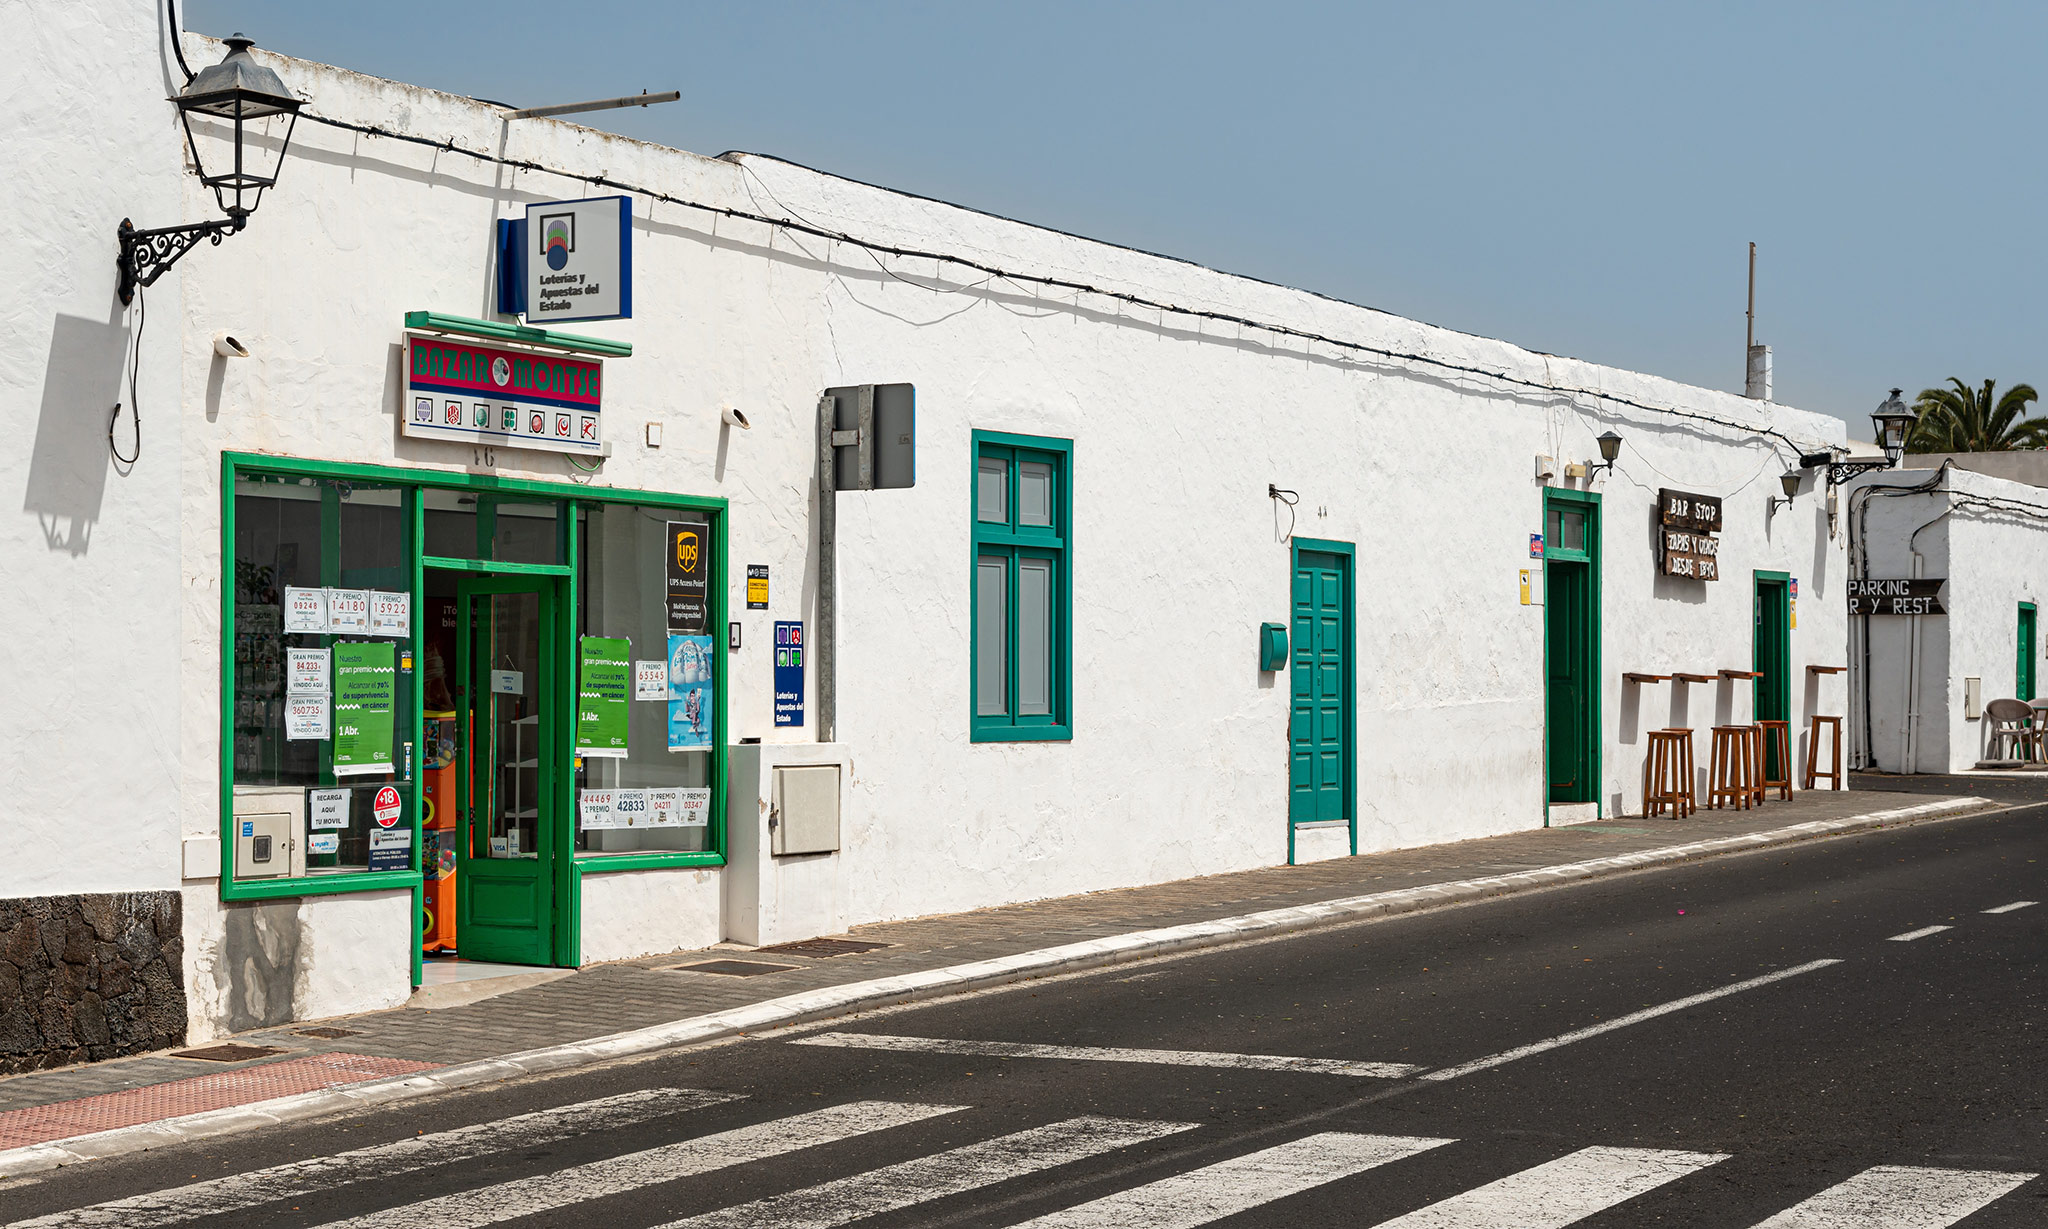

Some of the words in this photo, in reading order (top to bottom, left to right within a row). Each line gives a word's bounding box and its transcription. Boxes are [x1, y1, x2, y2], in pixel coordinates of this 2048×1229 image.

[540, 273, 578, 285] Loterías
[579, 274, 586, 284] y
[540, 286, 582, 300] Apuestas
[584, 284, 599, 294] del
[540, 300, 572, 312] Estado
[413, 345, 490, 384] BAZAR
[514, 358, 598, 398] MONTSE
[1670, 498, 1688, 516] BAR
[1695, 502, 1716, 522] STOP
[1692, 536, 1697, 553] Y
[1672, 558, 1693, 576] DESDE
[670, 578, 679, 586] UPS
[680, 579, 692, 587] Access
[693, 580, 704, 588] Point
[1848, 580, 1910, 596] PARKING
[294, 602, 318, 610] 09248
[332, 600, 366, 612] 14180
[374, 602, 406, 614] 15922
[1871, 598, 1880, 614] Y
[1893, 597, 1932, 614] REST
[595, 658, 612, 666] premio
[339, 667, 352, 675] gran
[353, 665, 372, 674] premio
[639, 671, 664, 680] 65545
[351, 691, 389, 699] supervivencia
[794, 693, 798, 701] y
[582, 712, 585, 721] 1
[586, 712, 599, 721] Abr.
[776, 714, 791, 722] Estado
[339, 726, 343, 736] 1
[344, 726, 359, 735] Abr.
[379, 790, 394, 804] +18
[584, 794, 611, 803] 44469
[656, 792, 676, 800] PREMIO
[687, 792, 707, 800] PREMIO
[589, 805, 610, 813] PREMIO
[617, 801, 645, 812] 42833
[654, 802, 671, 810] 04211
[684, 801, 703, 809] 03347
